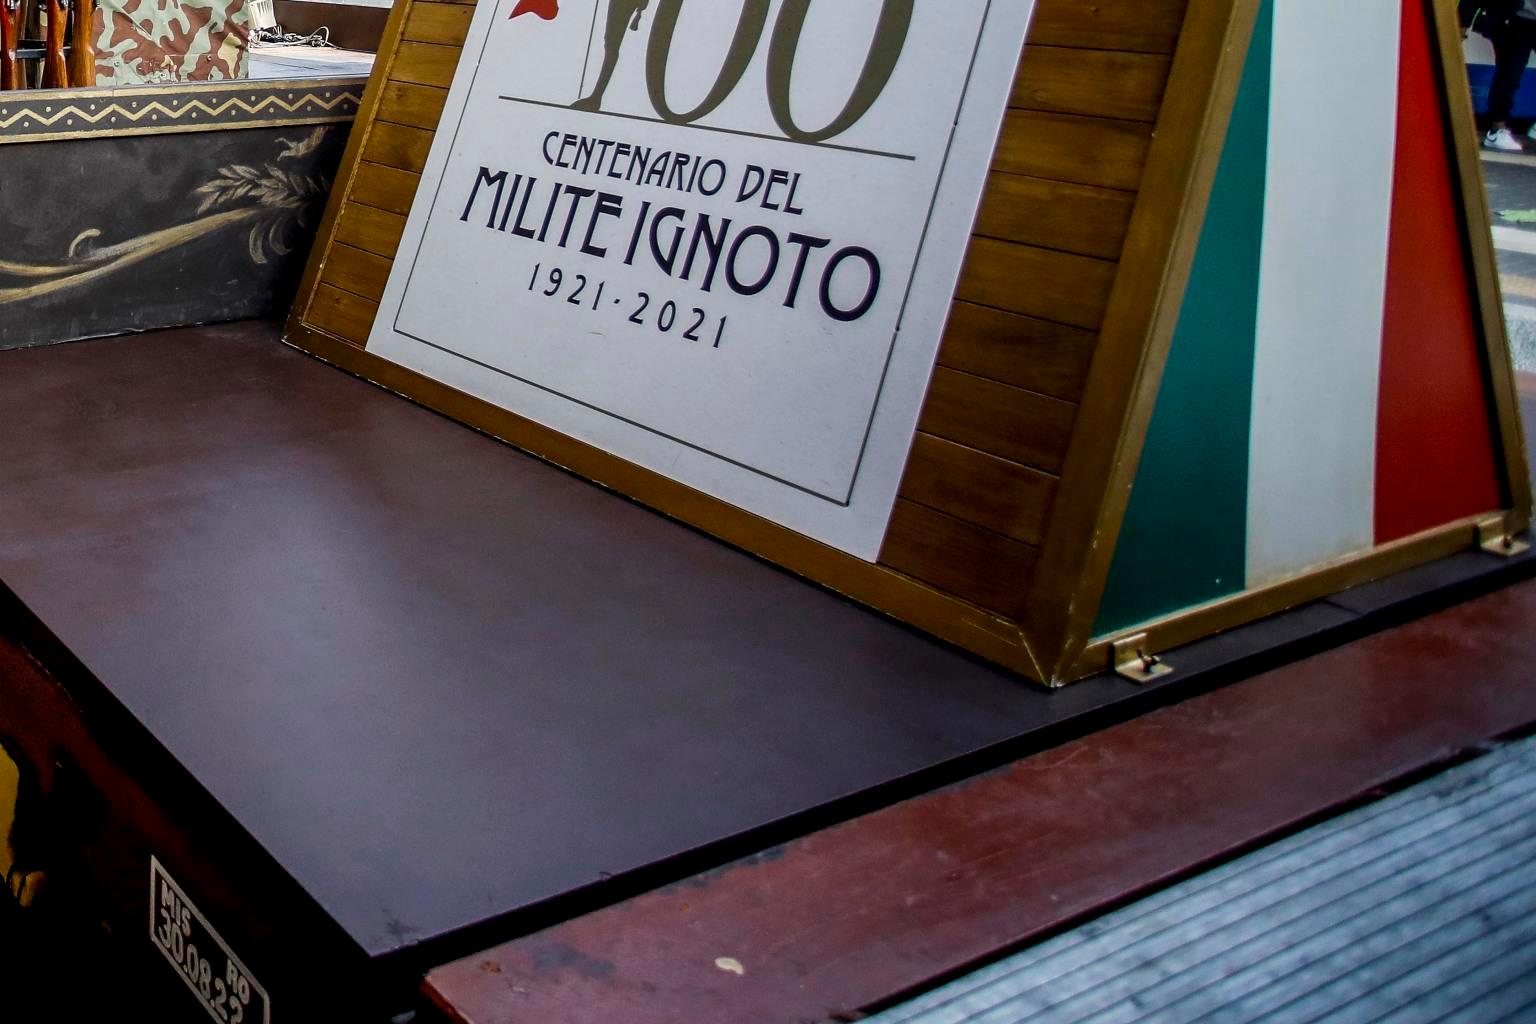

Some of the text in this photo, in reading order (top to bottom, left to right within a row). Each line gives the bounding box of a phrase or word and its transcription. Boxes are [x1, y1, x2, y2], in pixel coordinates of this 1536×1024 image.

[542, 130, 804, 216] CENTENARIO DEL
[459, 165, 882, 323] MILITE IGNOTO
[161, 879, 191, 937] MIS
